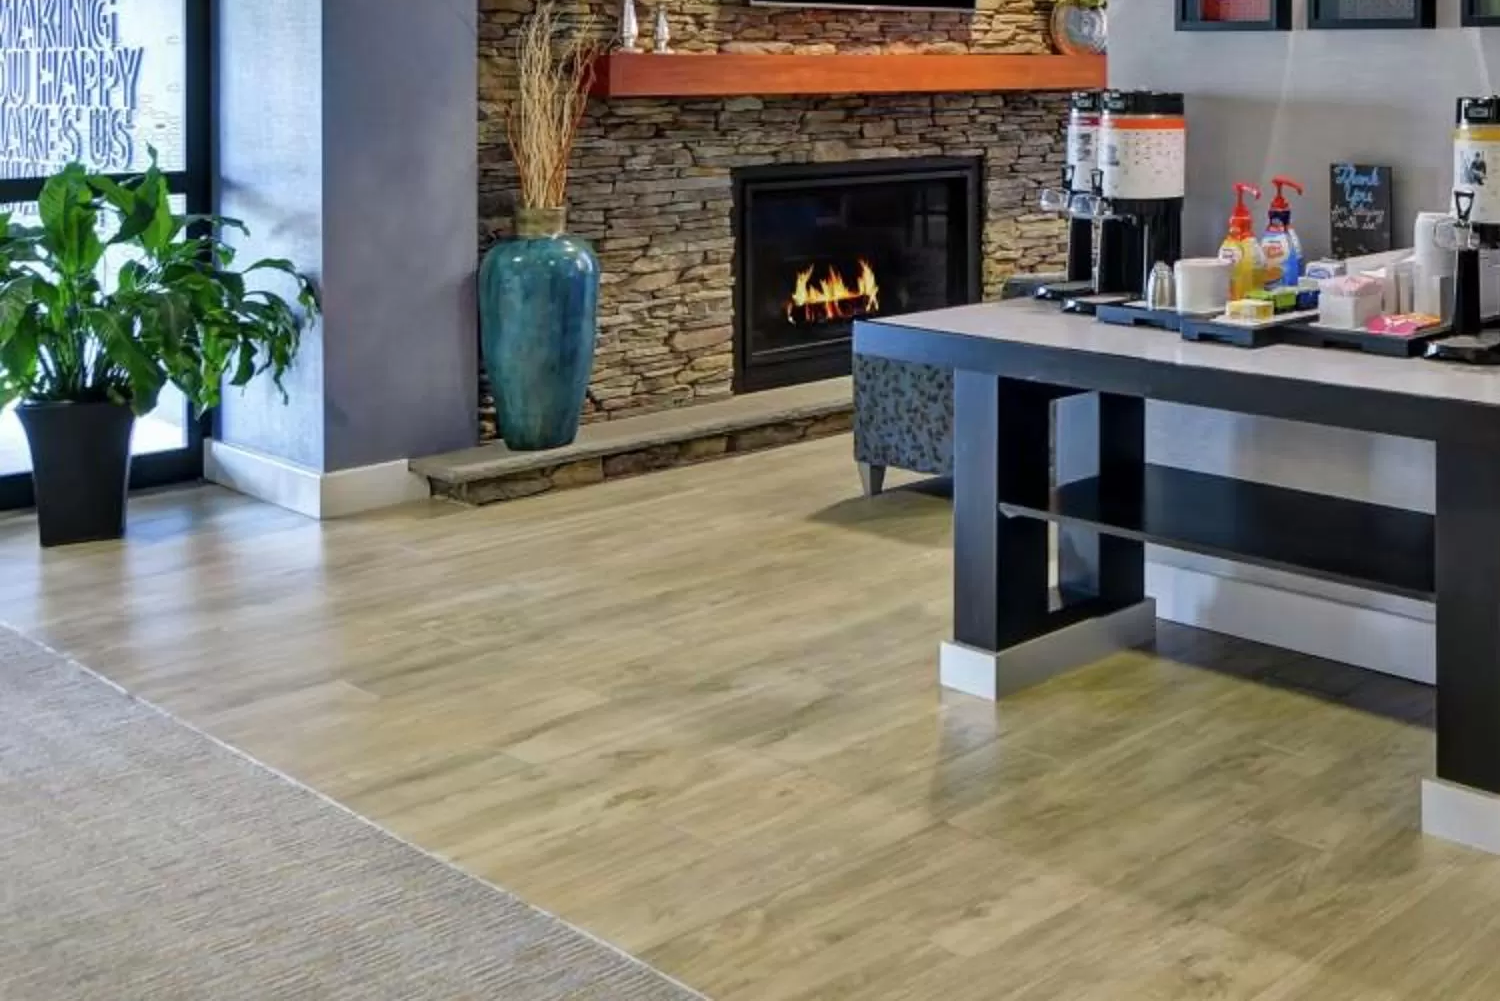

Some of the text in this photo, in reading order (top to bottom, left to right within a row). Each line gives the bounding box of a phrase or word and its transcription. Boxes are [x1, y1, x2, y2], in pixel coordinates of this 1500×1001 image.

[37, 46, 144, 109] HAPPY
[0, 105, 135, 170] AKES US
